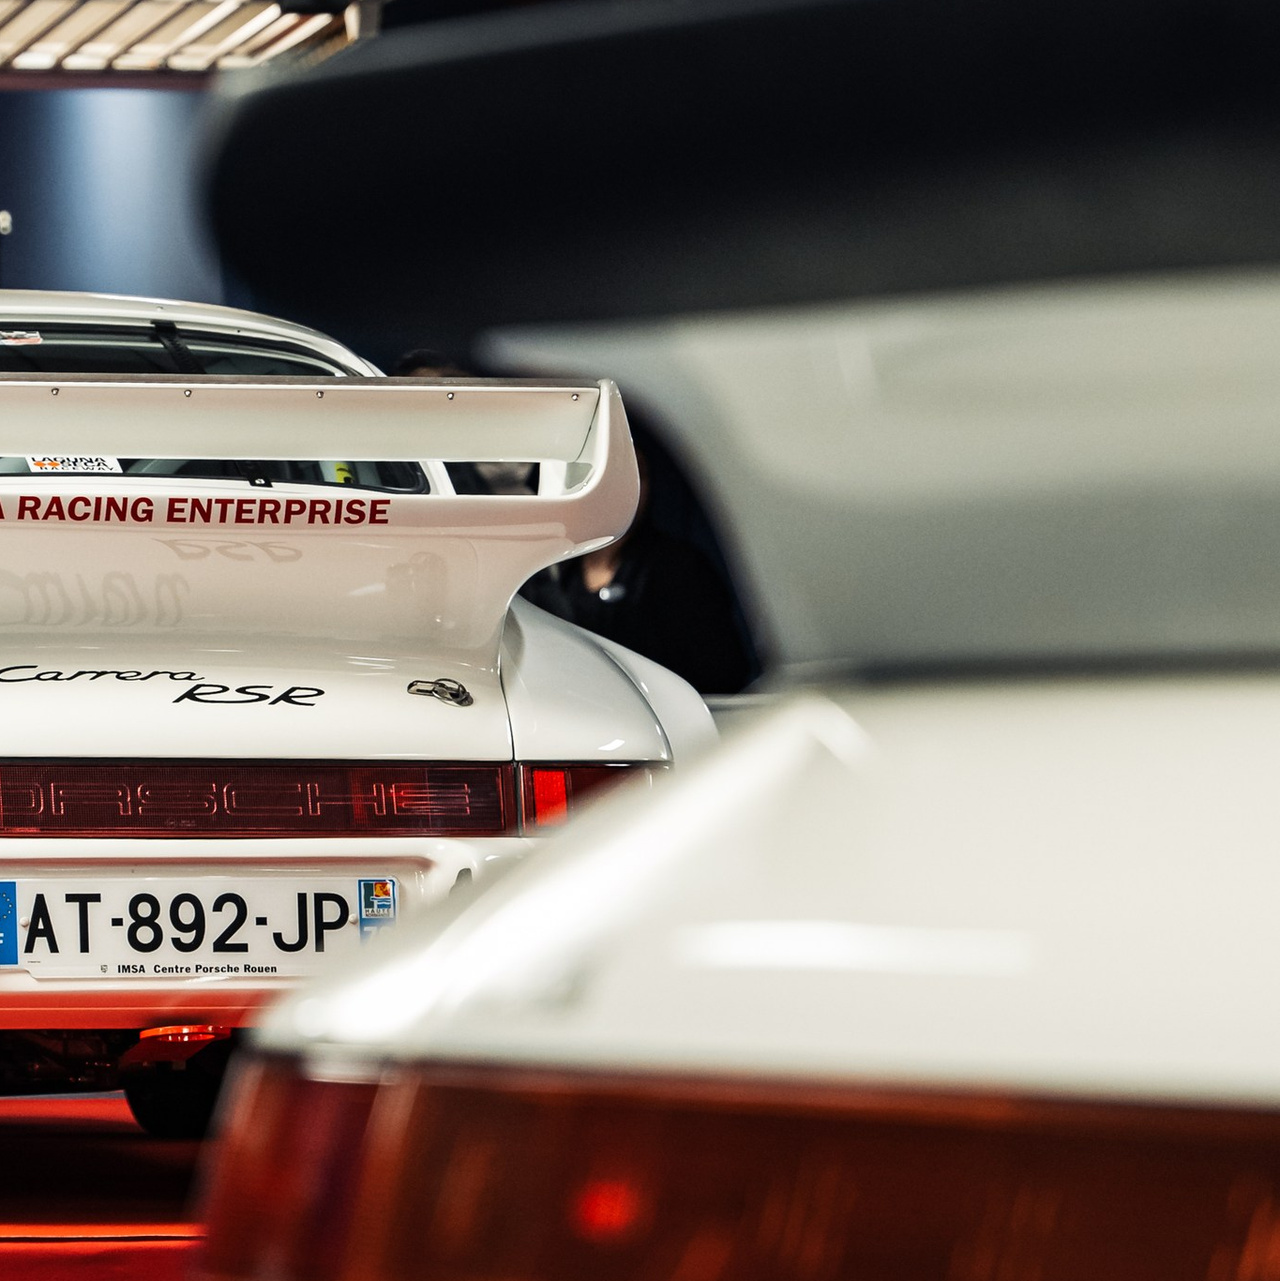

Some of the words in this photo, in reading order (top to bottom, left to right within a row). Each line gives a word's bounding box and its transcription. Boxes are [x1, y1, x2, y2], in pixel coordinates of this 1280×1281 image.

[17, 495, 154, 523] RACING
[165, 497, 392, 525] ENTERPRISE
[171, 683, 326, 707] RSR
[23, 892, 351, 954] AT-892-JP
[117, 964, 146, 974] IMSA
[153, 964, 192, 974] Centre
[195, 964, 240, 974] Porsche
[243, 964, 278, 974] Rouen
